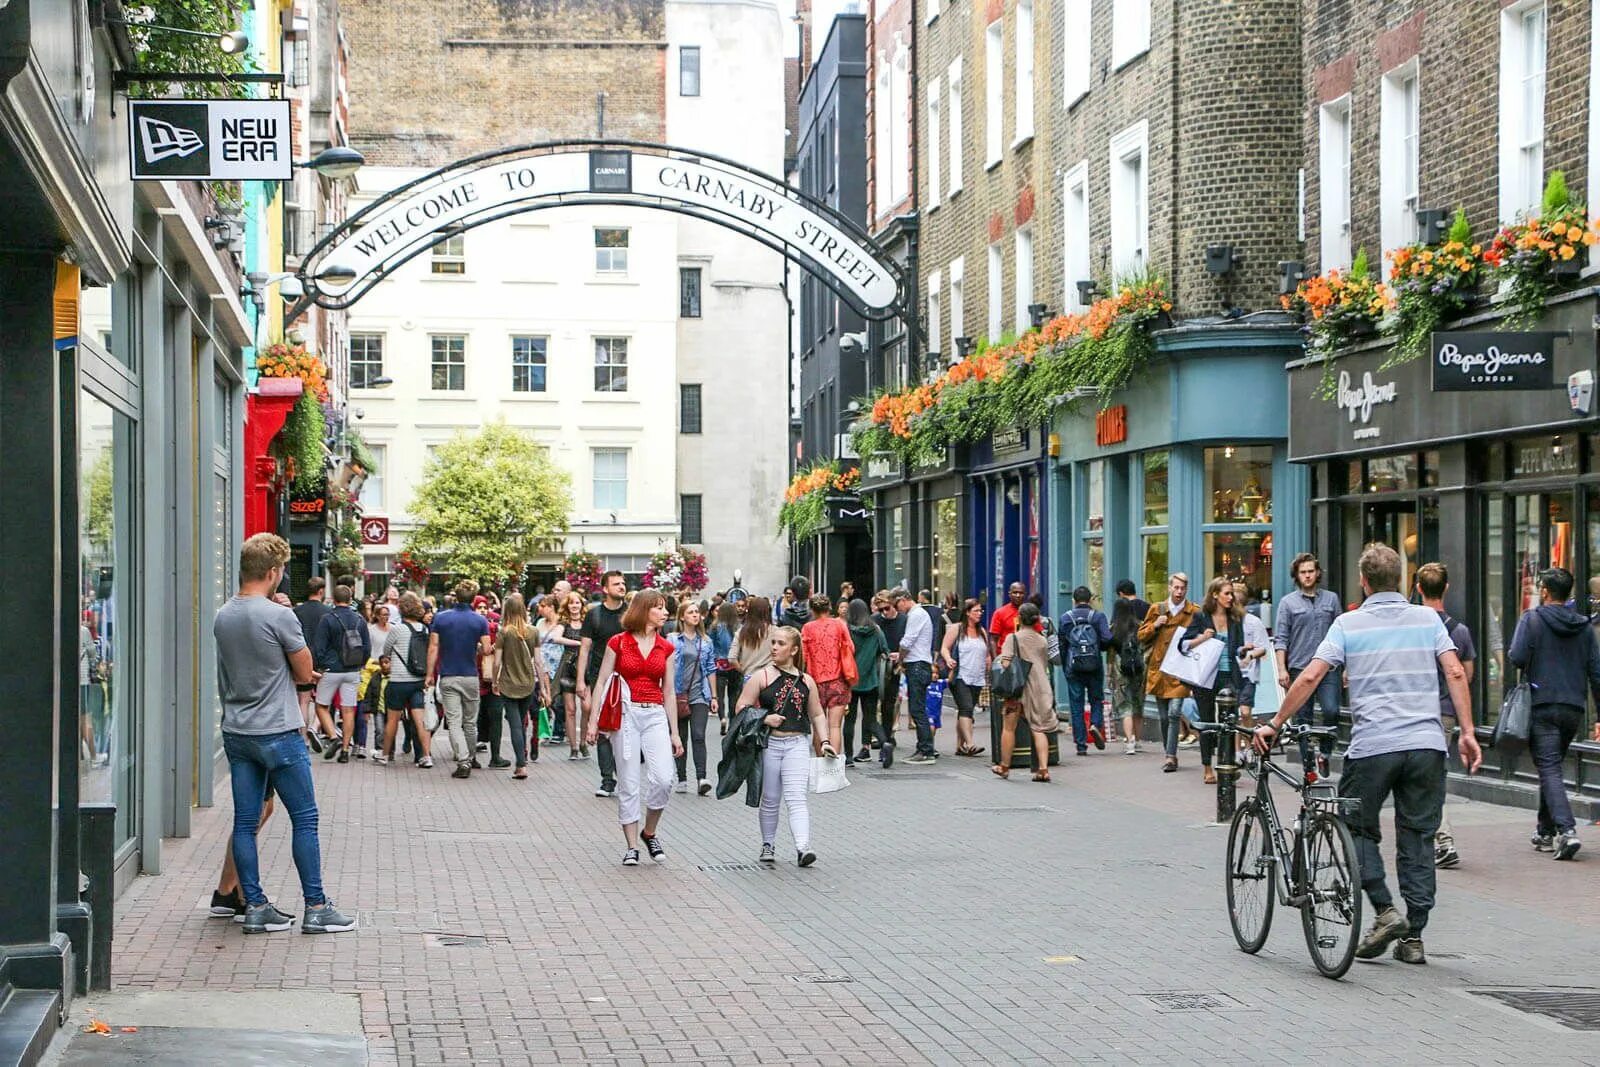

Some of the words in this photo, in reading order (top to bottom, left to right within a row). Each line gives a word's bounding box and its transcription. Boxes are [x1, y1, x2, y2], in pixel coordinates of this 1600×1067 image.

[221, 118, 277, 139] NEW
[222, 140, 278, 162] ERA
[353, 182, 480, 258] WELCOME
[500, 167, 536, 192] TO
[658, 166, 783, 222] CARNABY
[794, 219, 881, 290] STREET
[1438, 344, 1487, 373] Pepe
[1484, 345, 1546, 374] Jeans
[289, 498, 325, 512] size?
